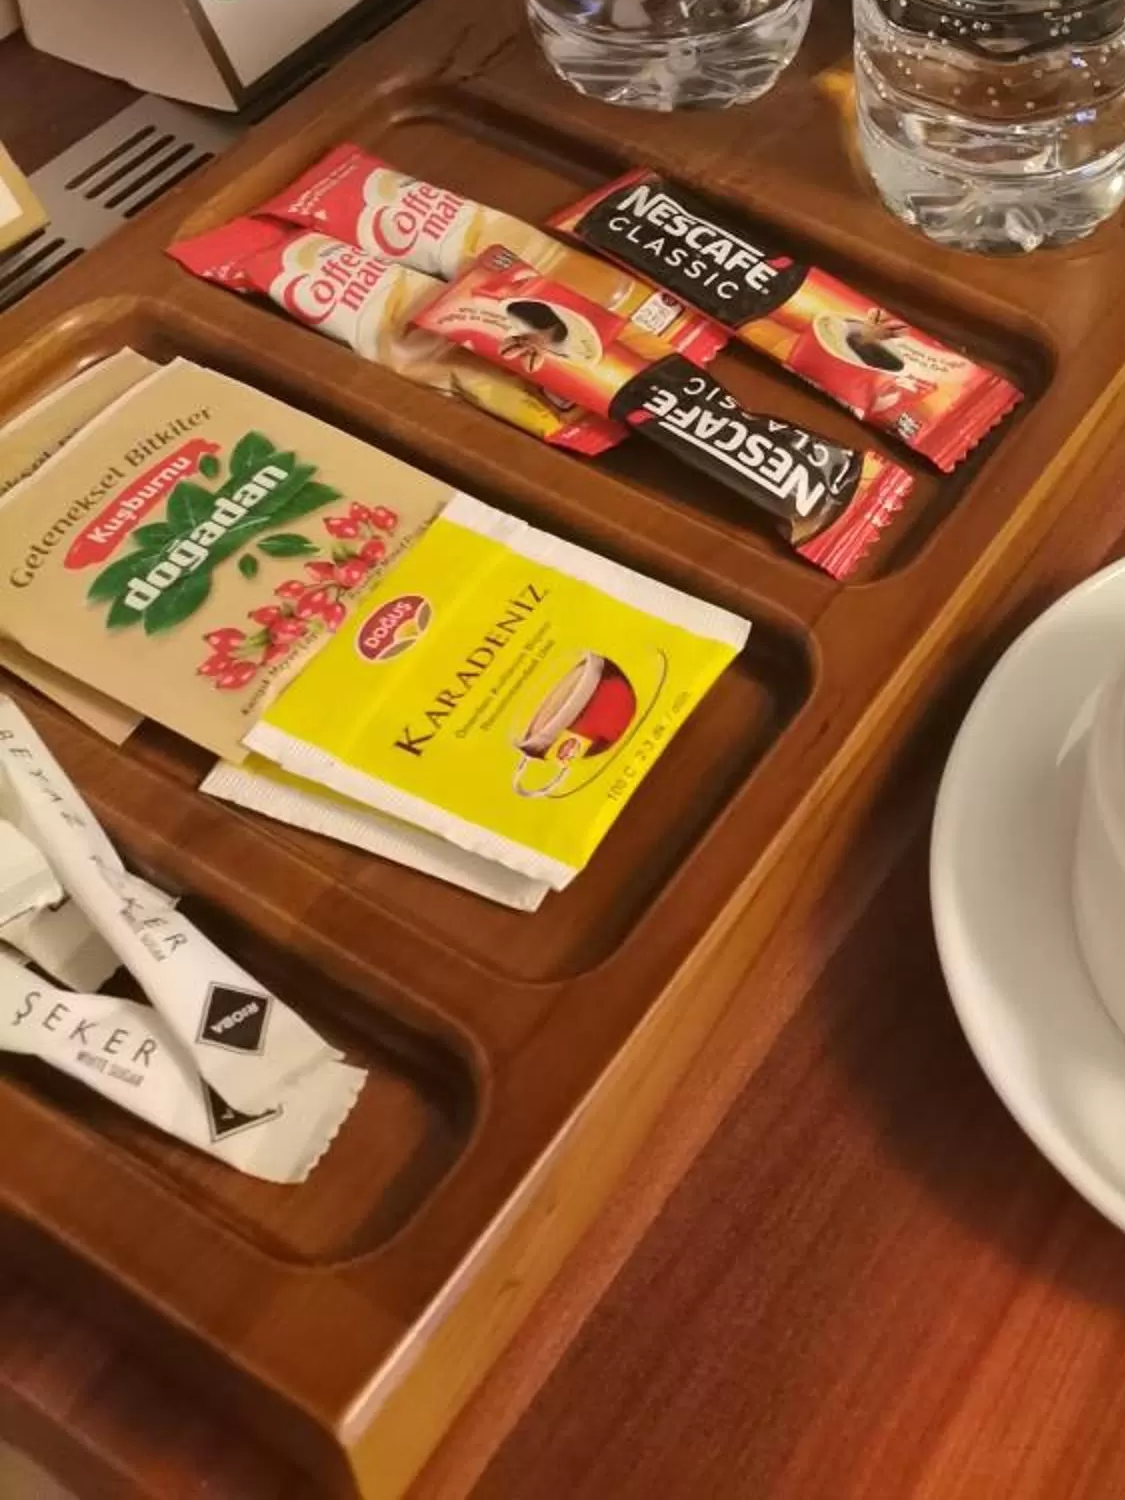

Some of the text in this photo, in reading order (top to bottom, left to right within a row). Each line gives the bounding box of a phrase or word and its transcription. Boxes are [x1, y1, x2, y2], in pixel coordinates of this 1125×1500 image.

[373, 185, 440, 257] Coffe
[422, 194, 467, 241] mat
[608, 217, 740, 300] CLASSIC
[10, 466, 125, 589] Geleneksel
[124, 407, 212, 468] Bitkiler
[87, 456, 192, 544] Kuşburnu
[124, 465, 288, 611] doğadan
[393, 583, 548, 757] KARADENİZ
[11, 991, 158, 1068] ŞEKER
